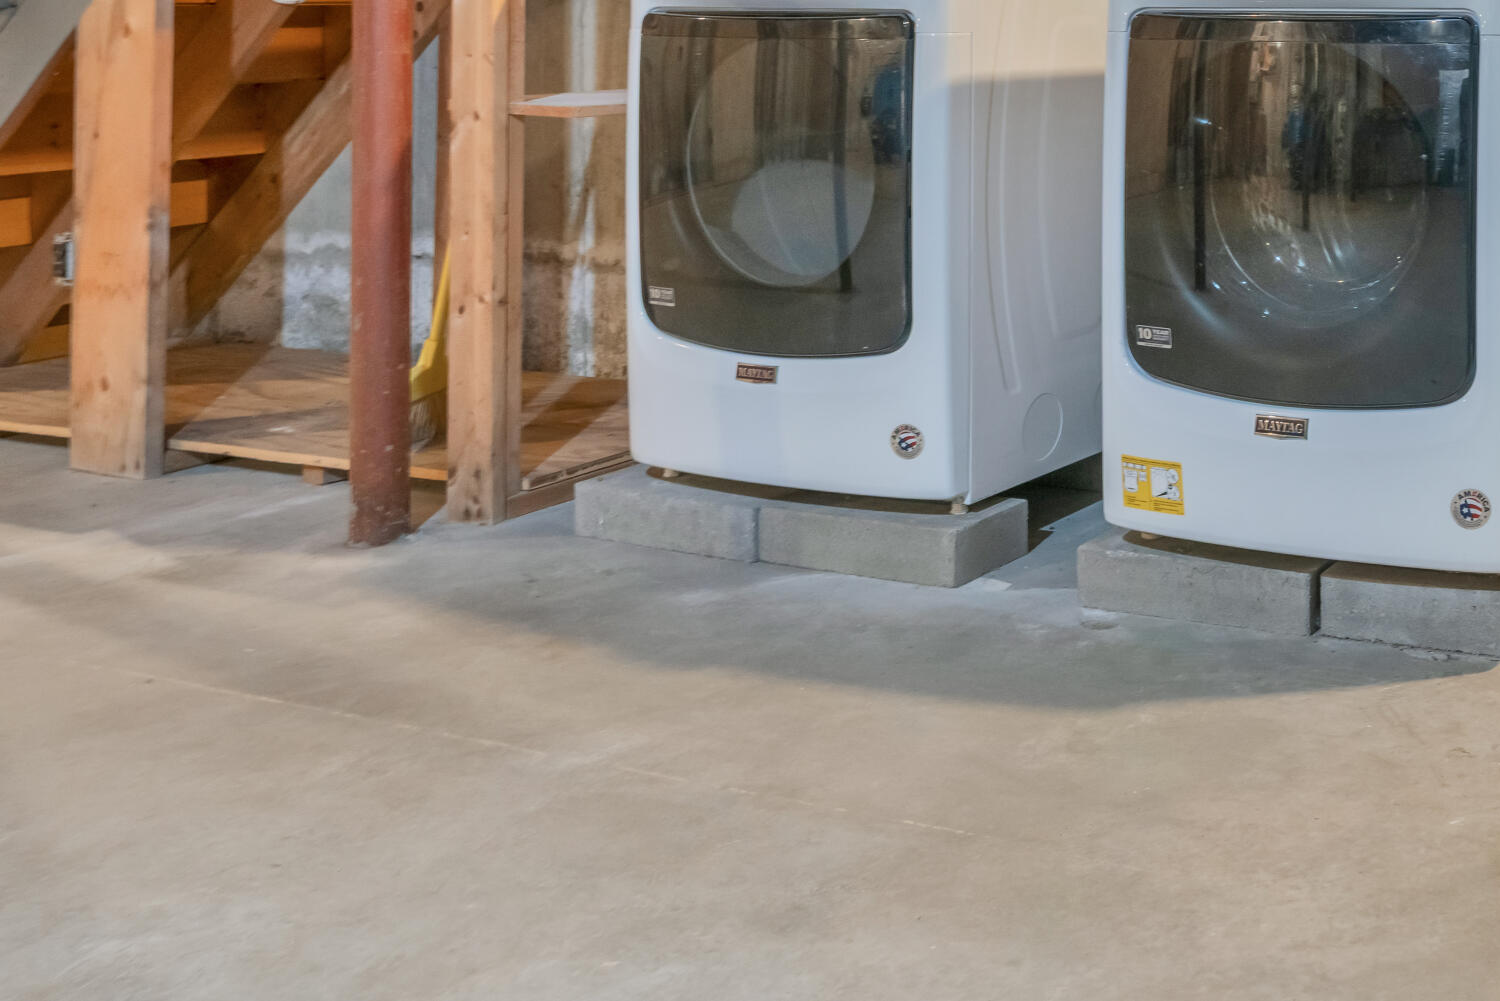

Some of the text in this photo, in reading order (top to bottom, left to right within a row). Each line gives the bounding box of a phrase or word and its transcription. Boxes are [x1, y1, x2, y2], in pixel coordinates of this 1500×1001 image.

[1137, 327, 1153, 340] 10
[1256, 419, 1304, 434] MAYTAG
[1457, 490, 1491, 513] AMERICA
